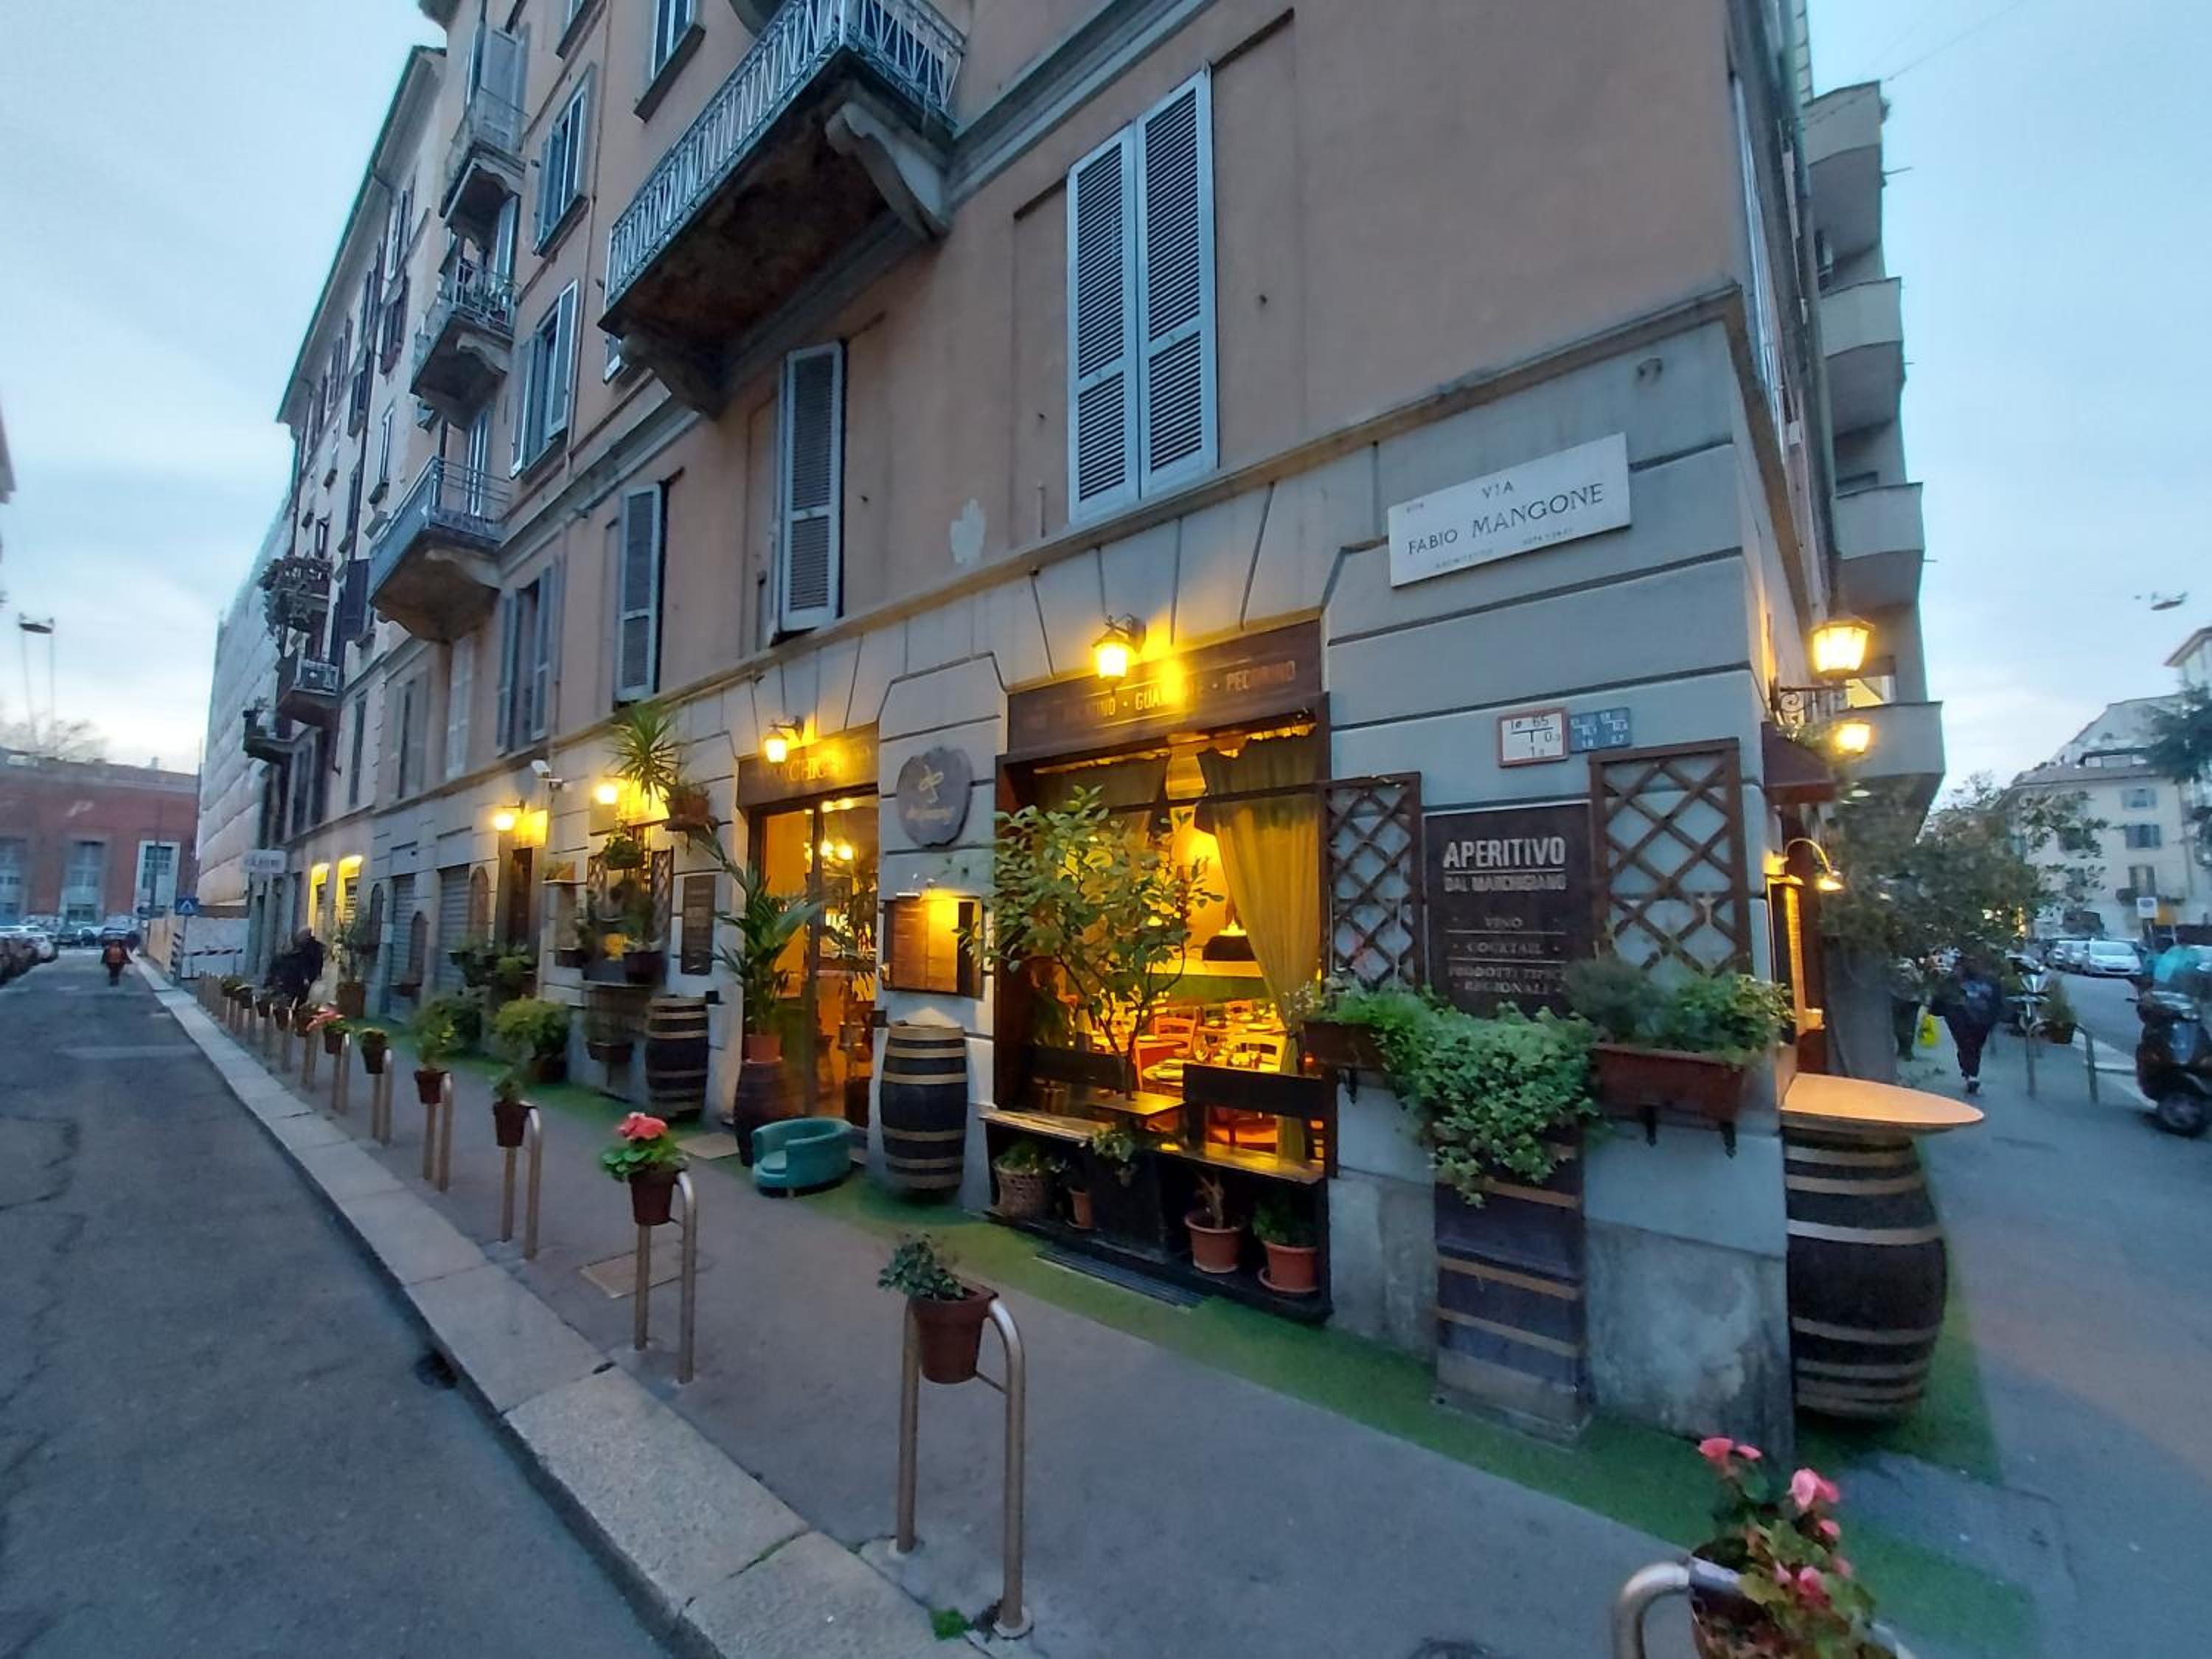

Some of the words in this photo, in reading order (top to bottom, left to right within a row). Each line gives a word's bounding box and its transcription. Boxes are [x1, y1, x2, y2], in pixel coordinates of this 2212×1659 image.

[1482, 480, 1514, 498] VIA
[1408, 529, 1458, 554] FABIO
[1472, 483, 1604, 538] MANGONE
[1442, 835, 1566, 869] APERITIVO
